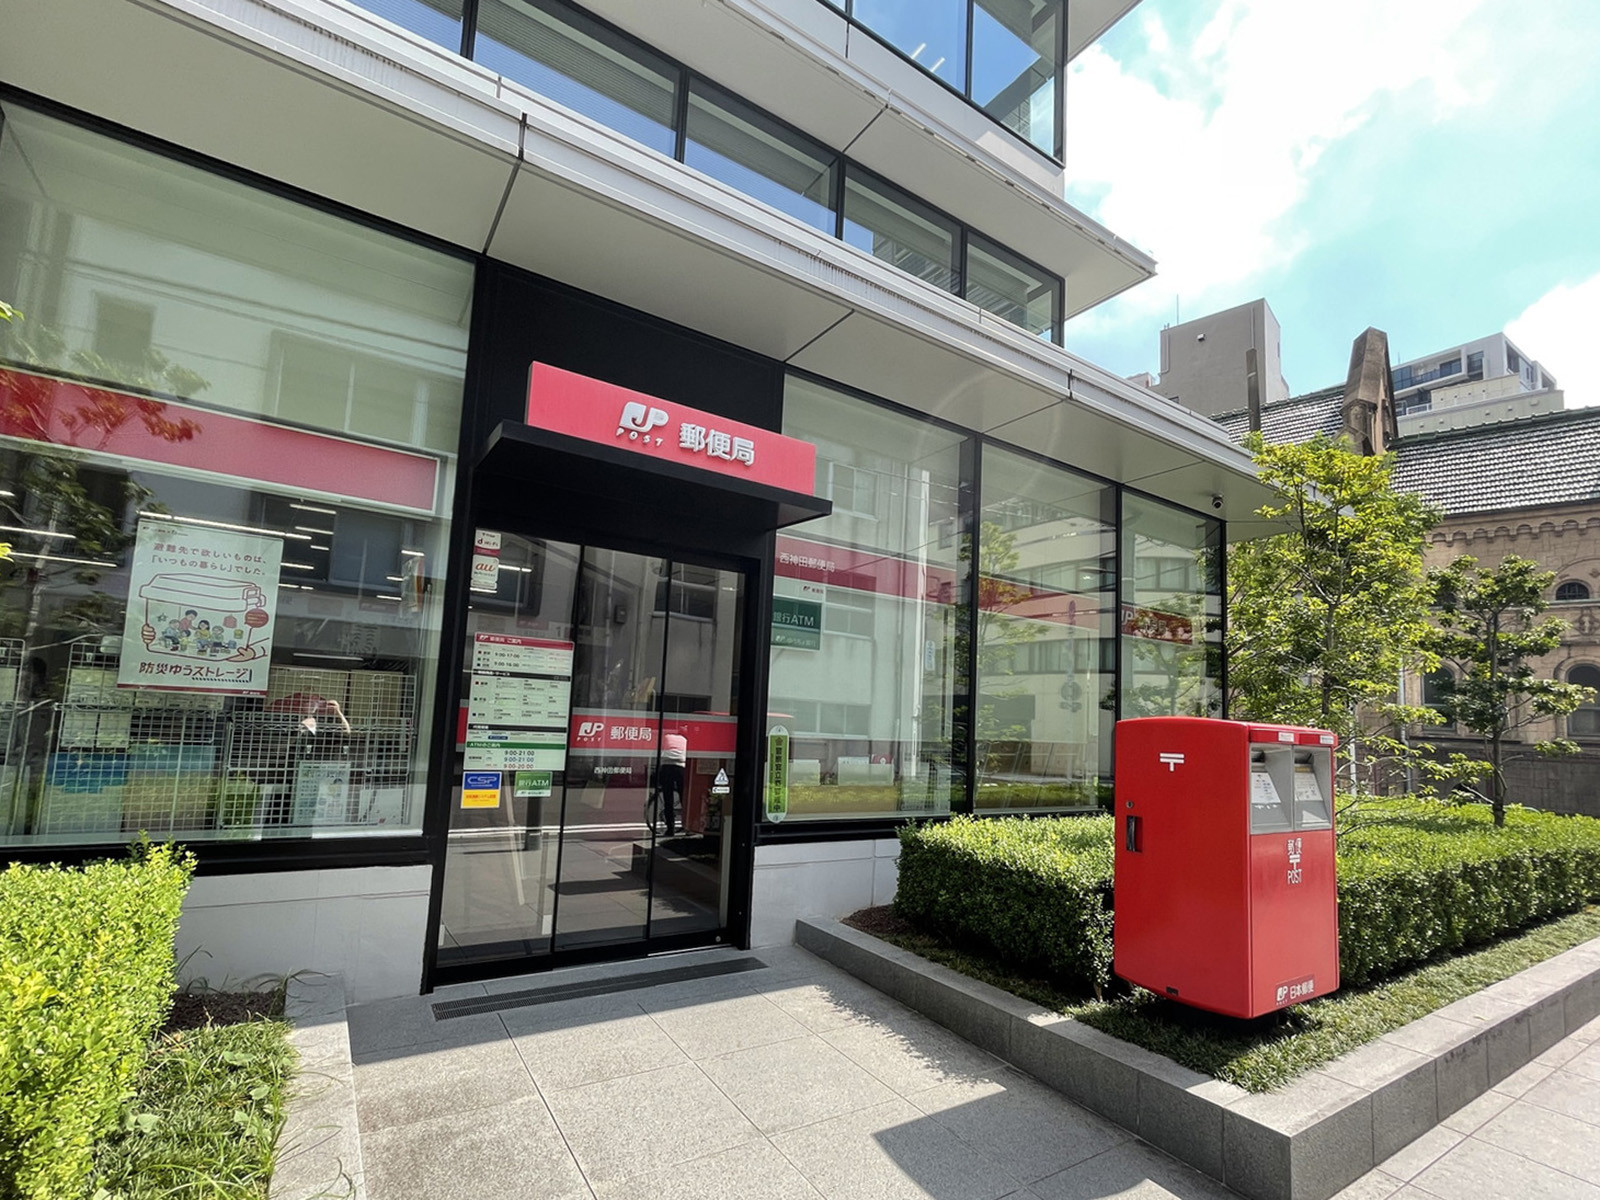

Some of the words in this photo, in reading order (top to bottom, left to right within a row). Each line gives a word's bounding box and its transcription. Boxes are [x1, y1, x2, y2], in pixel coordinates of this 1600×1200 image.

[616, 427, 663, 446] POST
[679, 422, 755, 466] 郵便局
[153, 542, 267, 564] 避難先で欲しいものは、
[151, 555, 266, 576] 「いつもの暮らし」でした。
[475, 563, 496, 572] au
[139, 661, 250, 679] 防災ゆうストレージ
[610, 726, 652, 742] 郵便局
[467, 776, 497, 784] CSP
[1287, 869, 1302, 884] POST
[1290, 979, 1314, 999] 日本郵便
